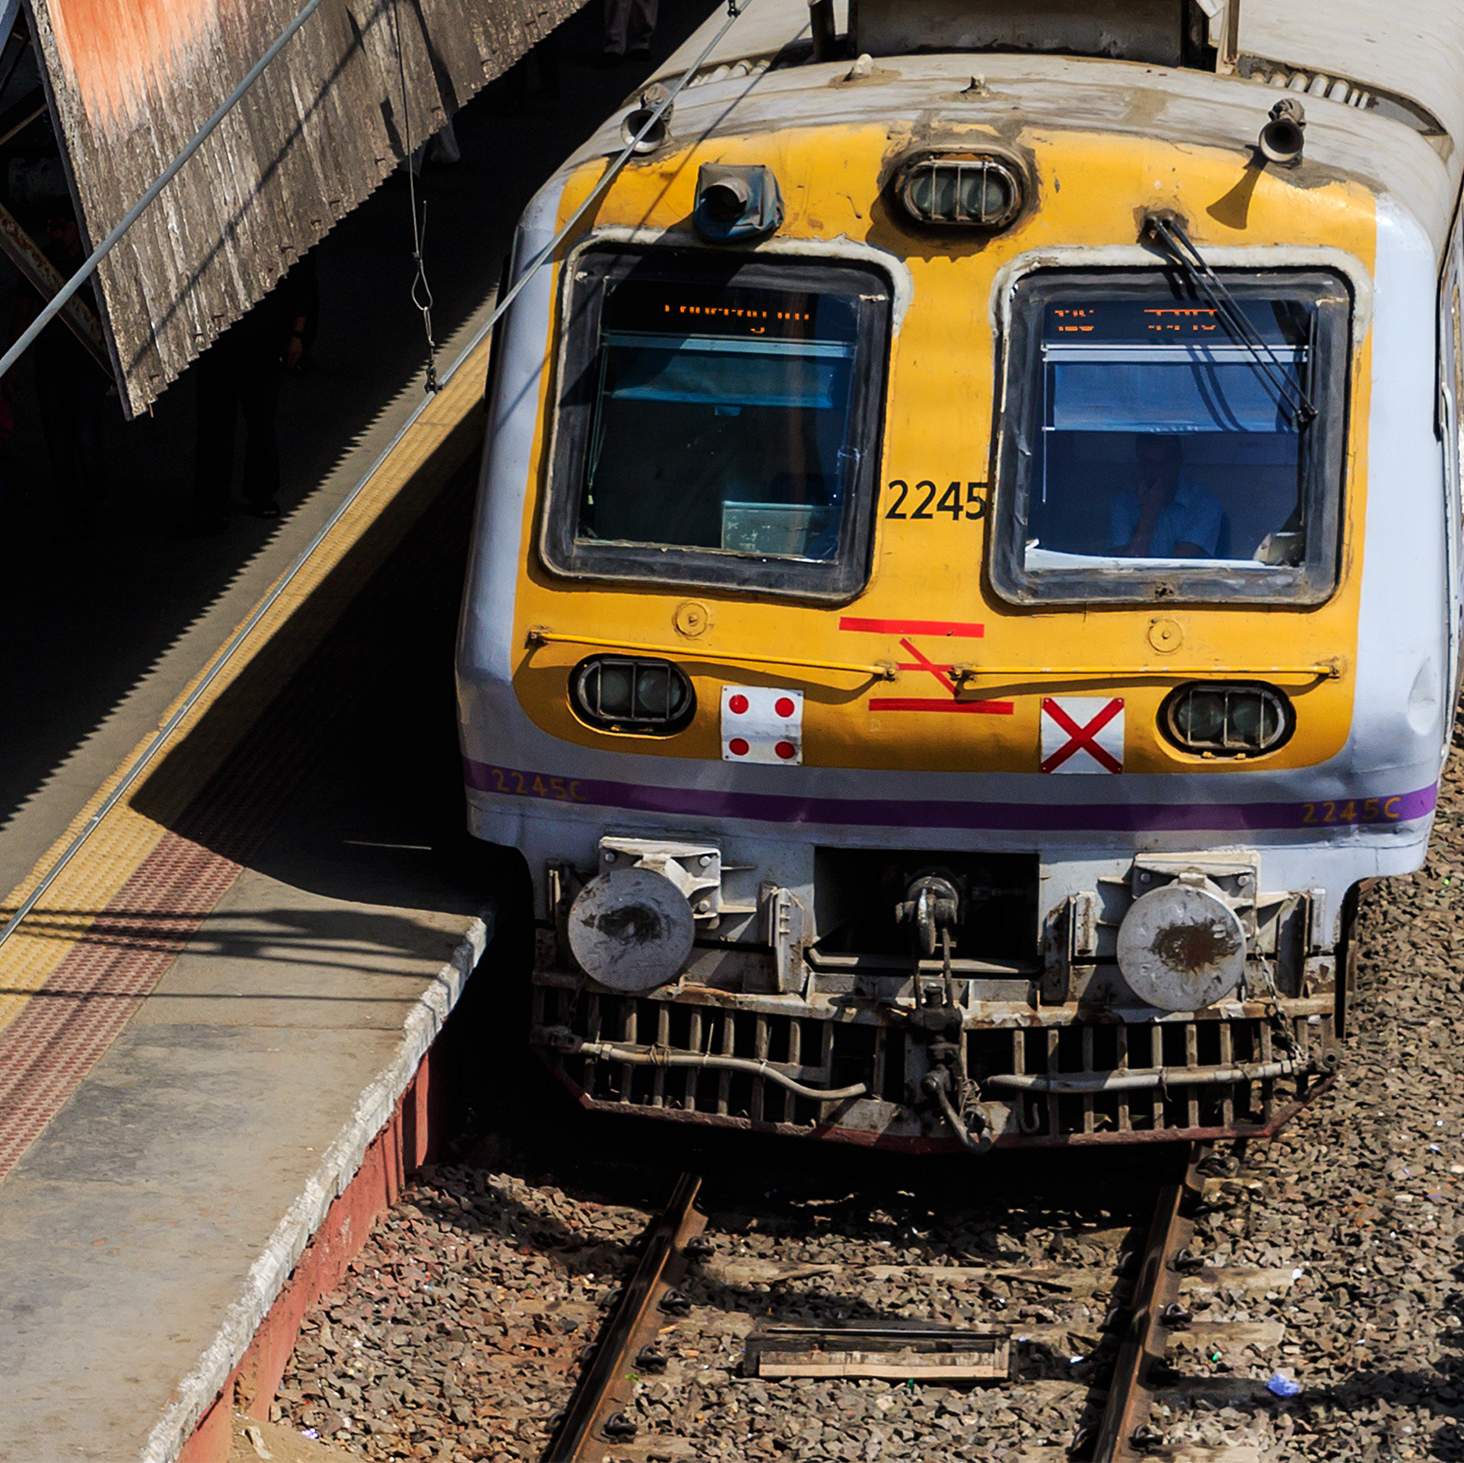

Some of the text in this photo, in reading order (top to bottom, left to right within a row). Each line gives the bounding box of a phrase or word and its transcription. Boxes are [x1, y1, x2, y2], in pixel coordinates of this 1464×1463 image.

[885, 479, 988, 521] 2245
[492, 768, 586, 801] 2245C
[1303, 797, 1401, 823] 2245C
